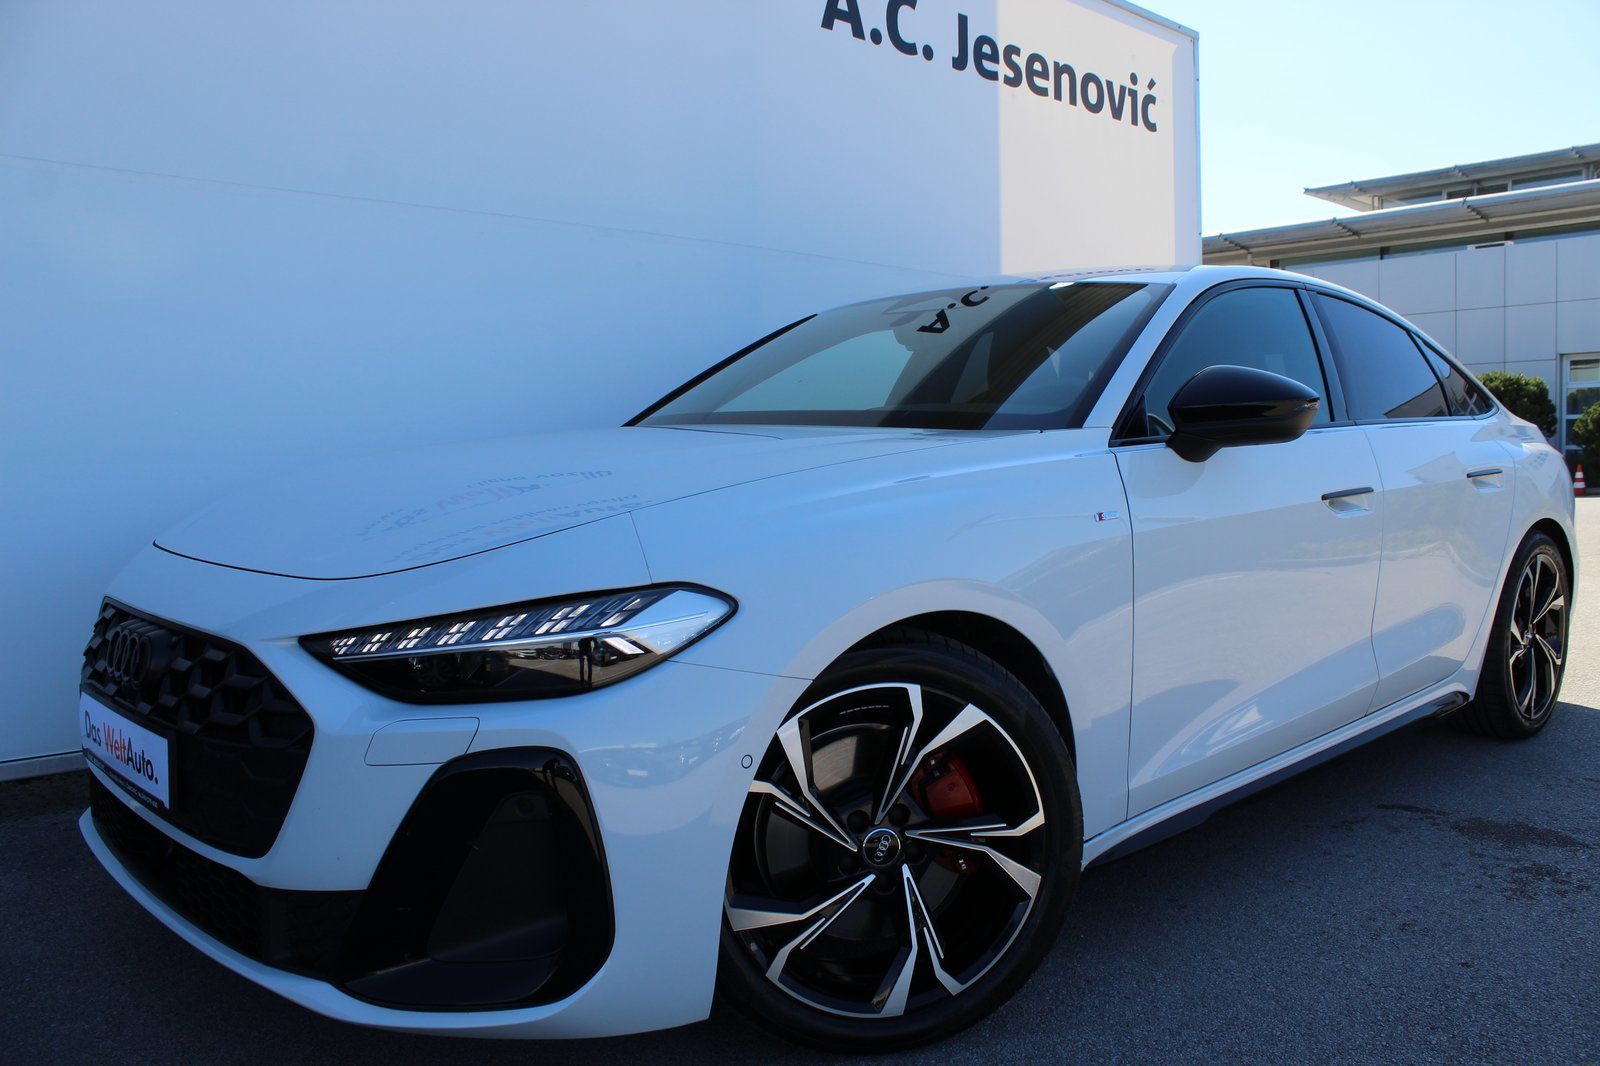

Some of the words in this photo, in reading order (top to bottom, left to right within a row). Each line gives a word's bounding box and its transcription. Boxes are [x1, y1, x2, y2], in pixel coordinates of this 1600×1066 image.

[951, 12, 1157, 133] Jesenović
[85, 710, 101, 746] Das
[104, 723, 158, 784] WeltAuto.
